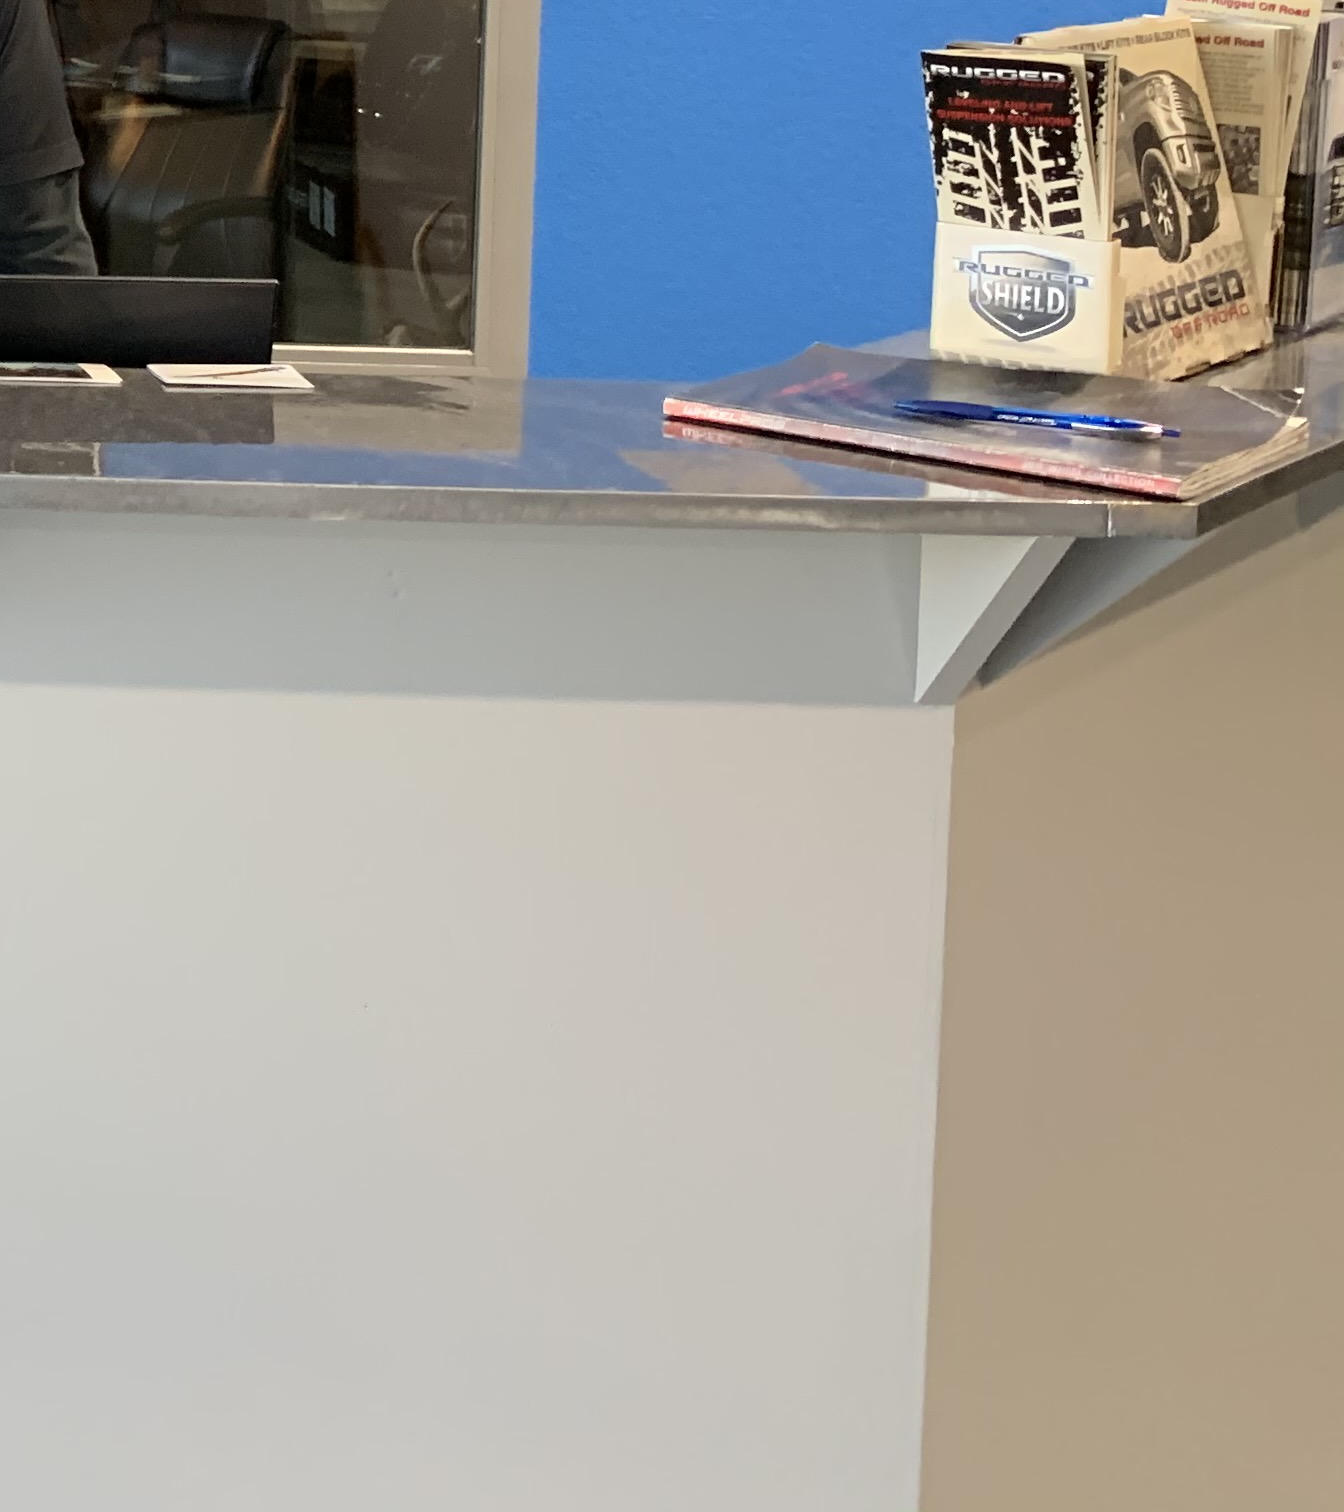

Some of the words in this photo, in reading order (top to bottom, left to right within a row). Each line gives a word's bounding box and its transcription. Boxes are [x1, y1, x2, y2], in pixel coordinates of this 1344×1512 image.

[1258, 0, 1277, 13] Off
[1279, 4, 1311, 18] Road
[1234, 37, 1265, 49] Road
[929, 63, 1066, 83] RUGGED
[958, 261, 1090, 288] RUGGED
[981, 281, 1065, 315] SHIELD
[1123, 269, 1246, 333] RUGGED
